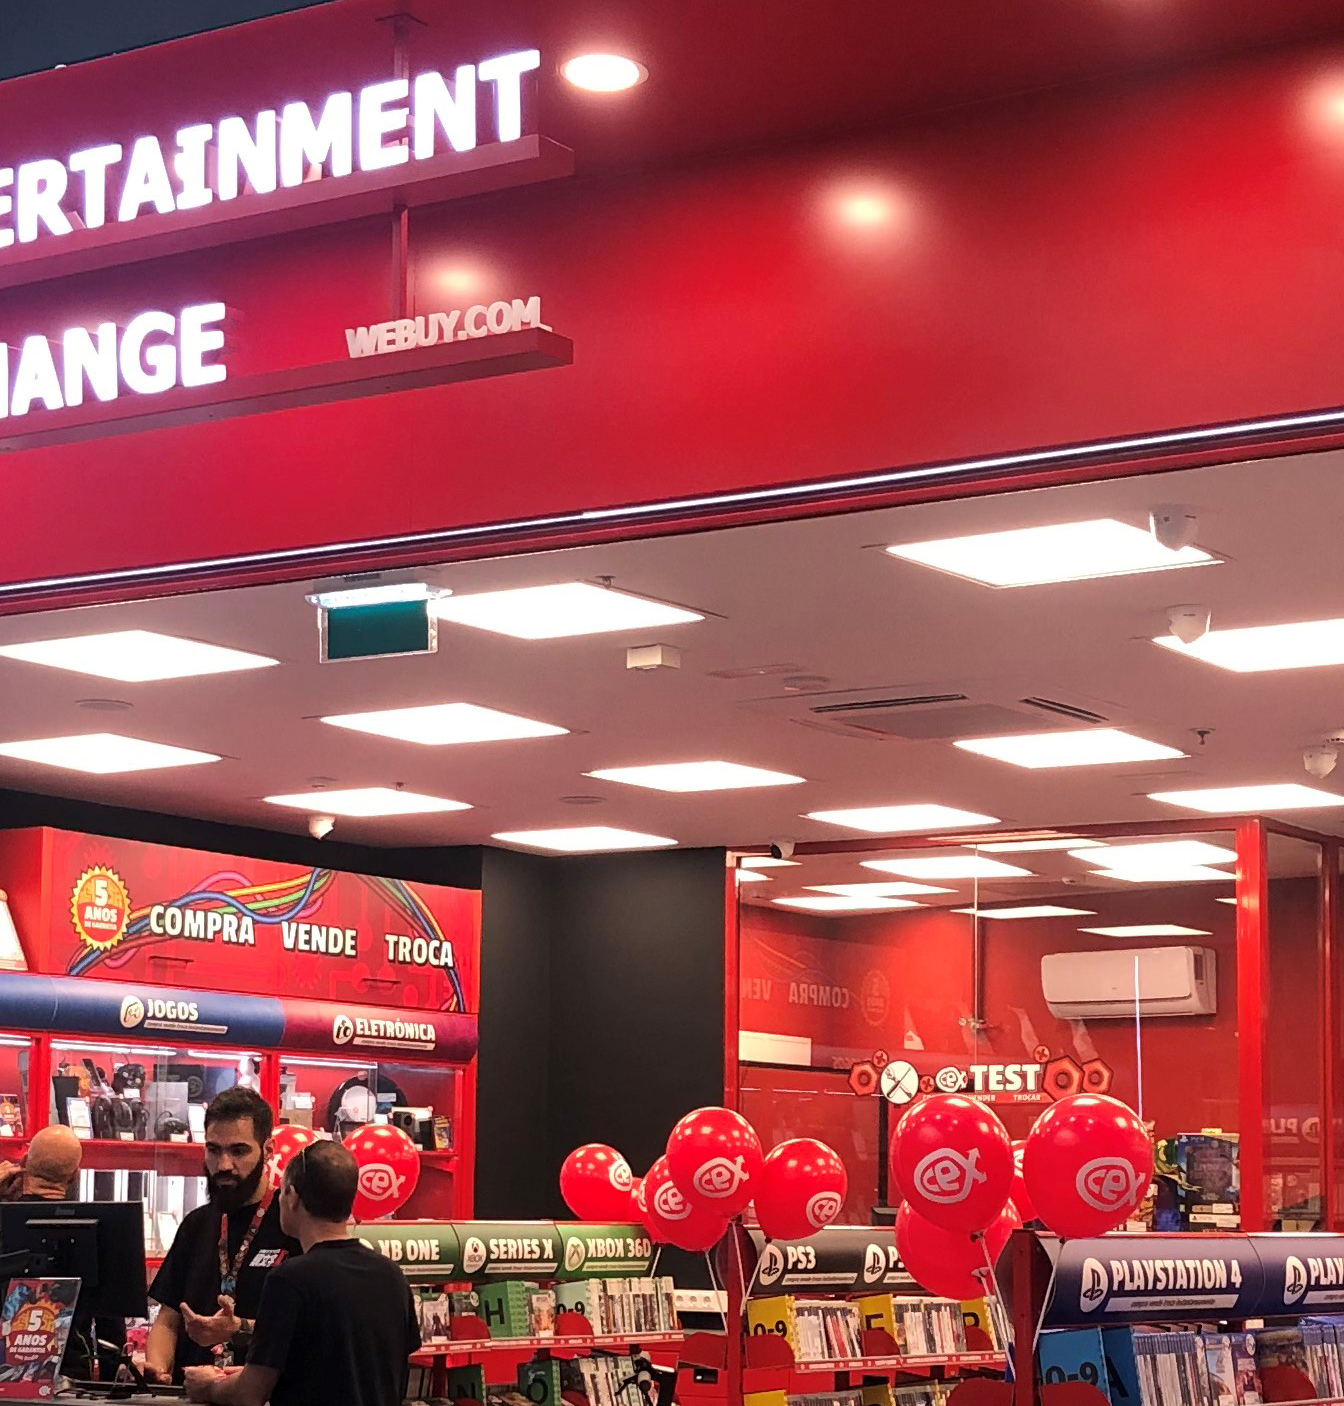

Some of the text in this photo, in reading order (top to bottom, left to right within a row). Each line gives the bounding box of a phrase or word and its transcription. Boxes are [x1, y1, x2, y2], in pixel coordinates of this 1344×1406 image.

[345, 296, 541, 358] WEBUY.COM
[94, 879, 108, 906] 5
[84, 906, 118, 923] ANOS
[150, 905, 454, 967] COMPRA VENDE TROCA
[147, 999, 199, 1021] JOGOS
[969, 1064, 1041, 1091] TEST
[406, 1239, 440, 1261] ONE
[489, 1238, 554, 1260] SERIES X
[586, 1237, 652, 1258] XBOX 360
[786, 1246, 816, 1270] PS3
[1110, 1259, 1242, 1291] PLAYSTATION 4
[27, 1309, 43, 1331] 5
[485, 1297, 505, 1327] H
[14, 1334, 47, 1346] ANOS
